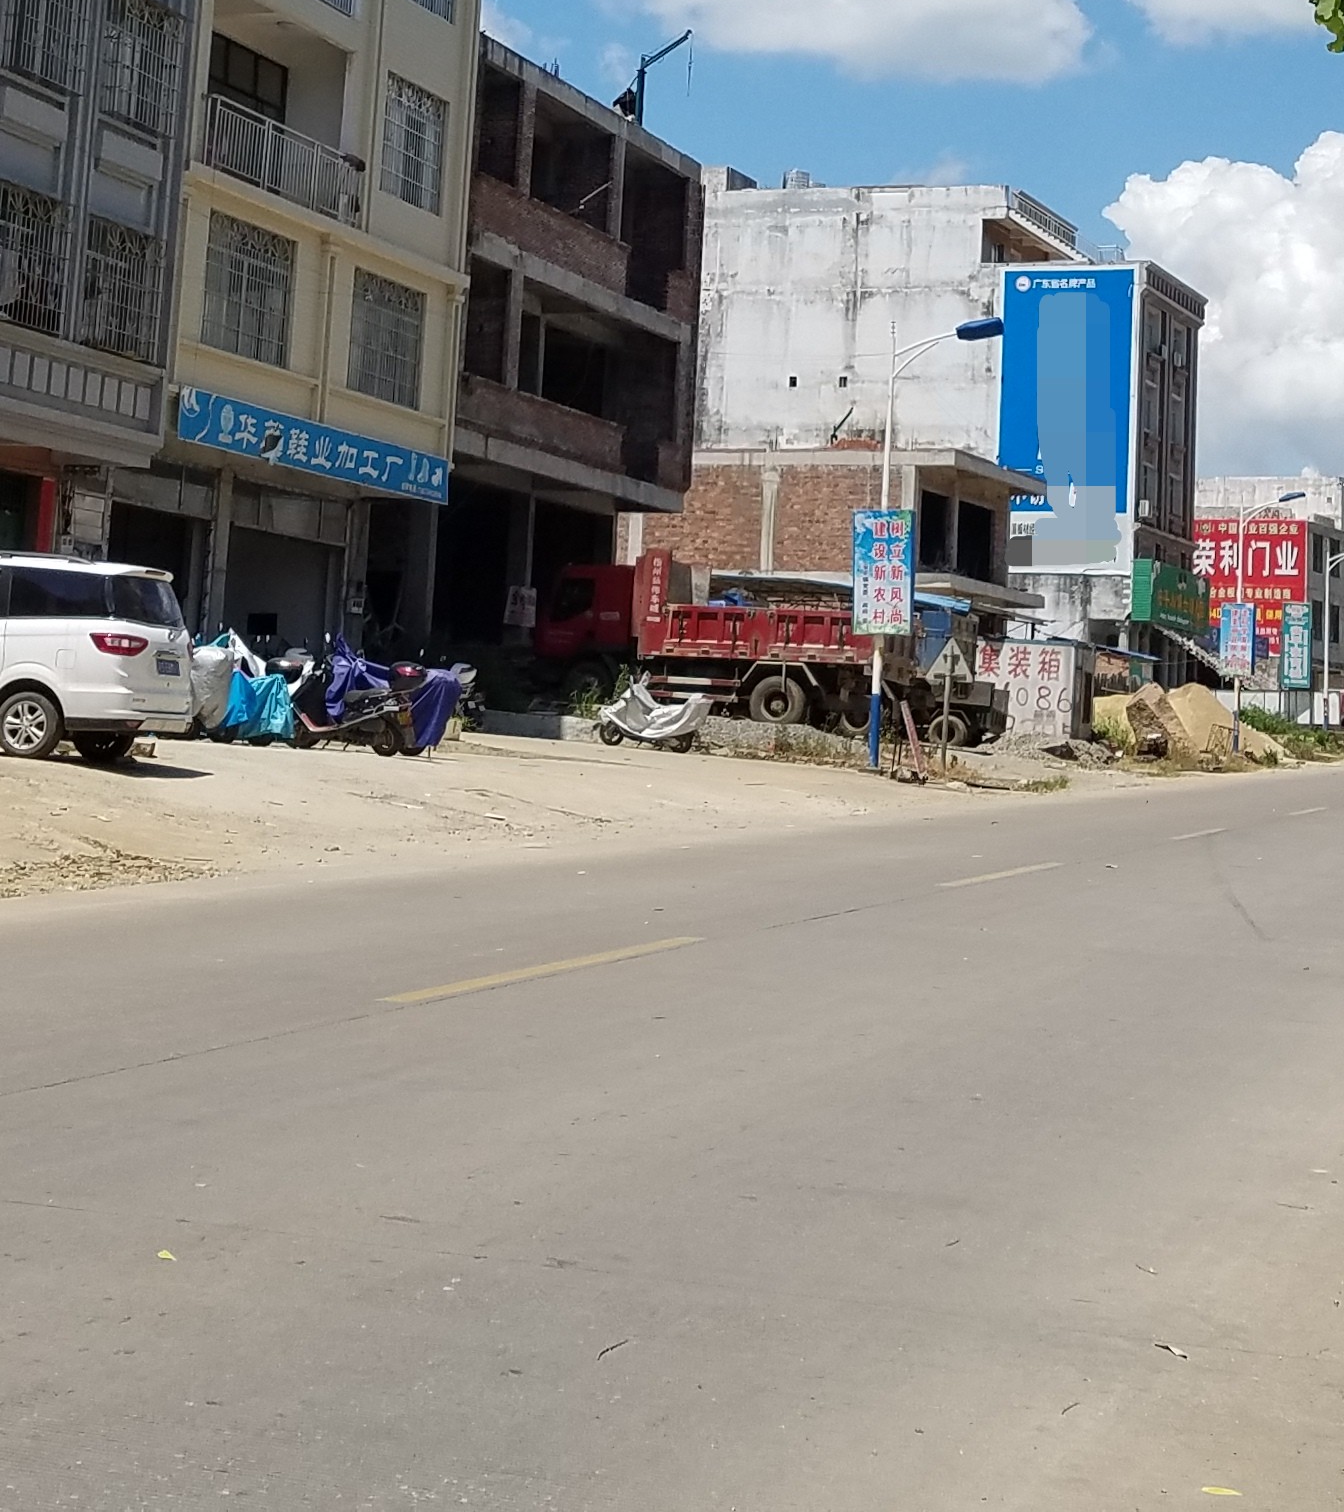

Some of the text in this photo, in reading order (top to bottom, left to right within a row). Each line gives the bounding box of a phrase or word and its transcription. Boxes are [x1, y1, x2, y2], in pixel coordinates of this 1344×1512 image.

[872, 520, 887, 625] 建设新农村
[889, 520, 905, 625] 树立新风尚
[1192, 538, 1299, 578] 荣利门业
[978, 644, 1062, 682] 集装箱
[1003, 681, 1073, 714] 086
